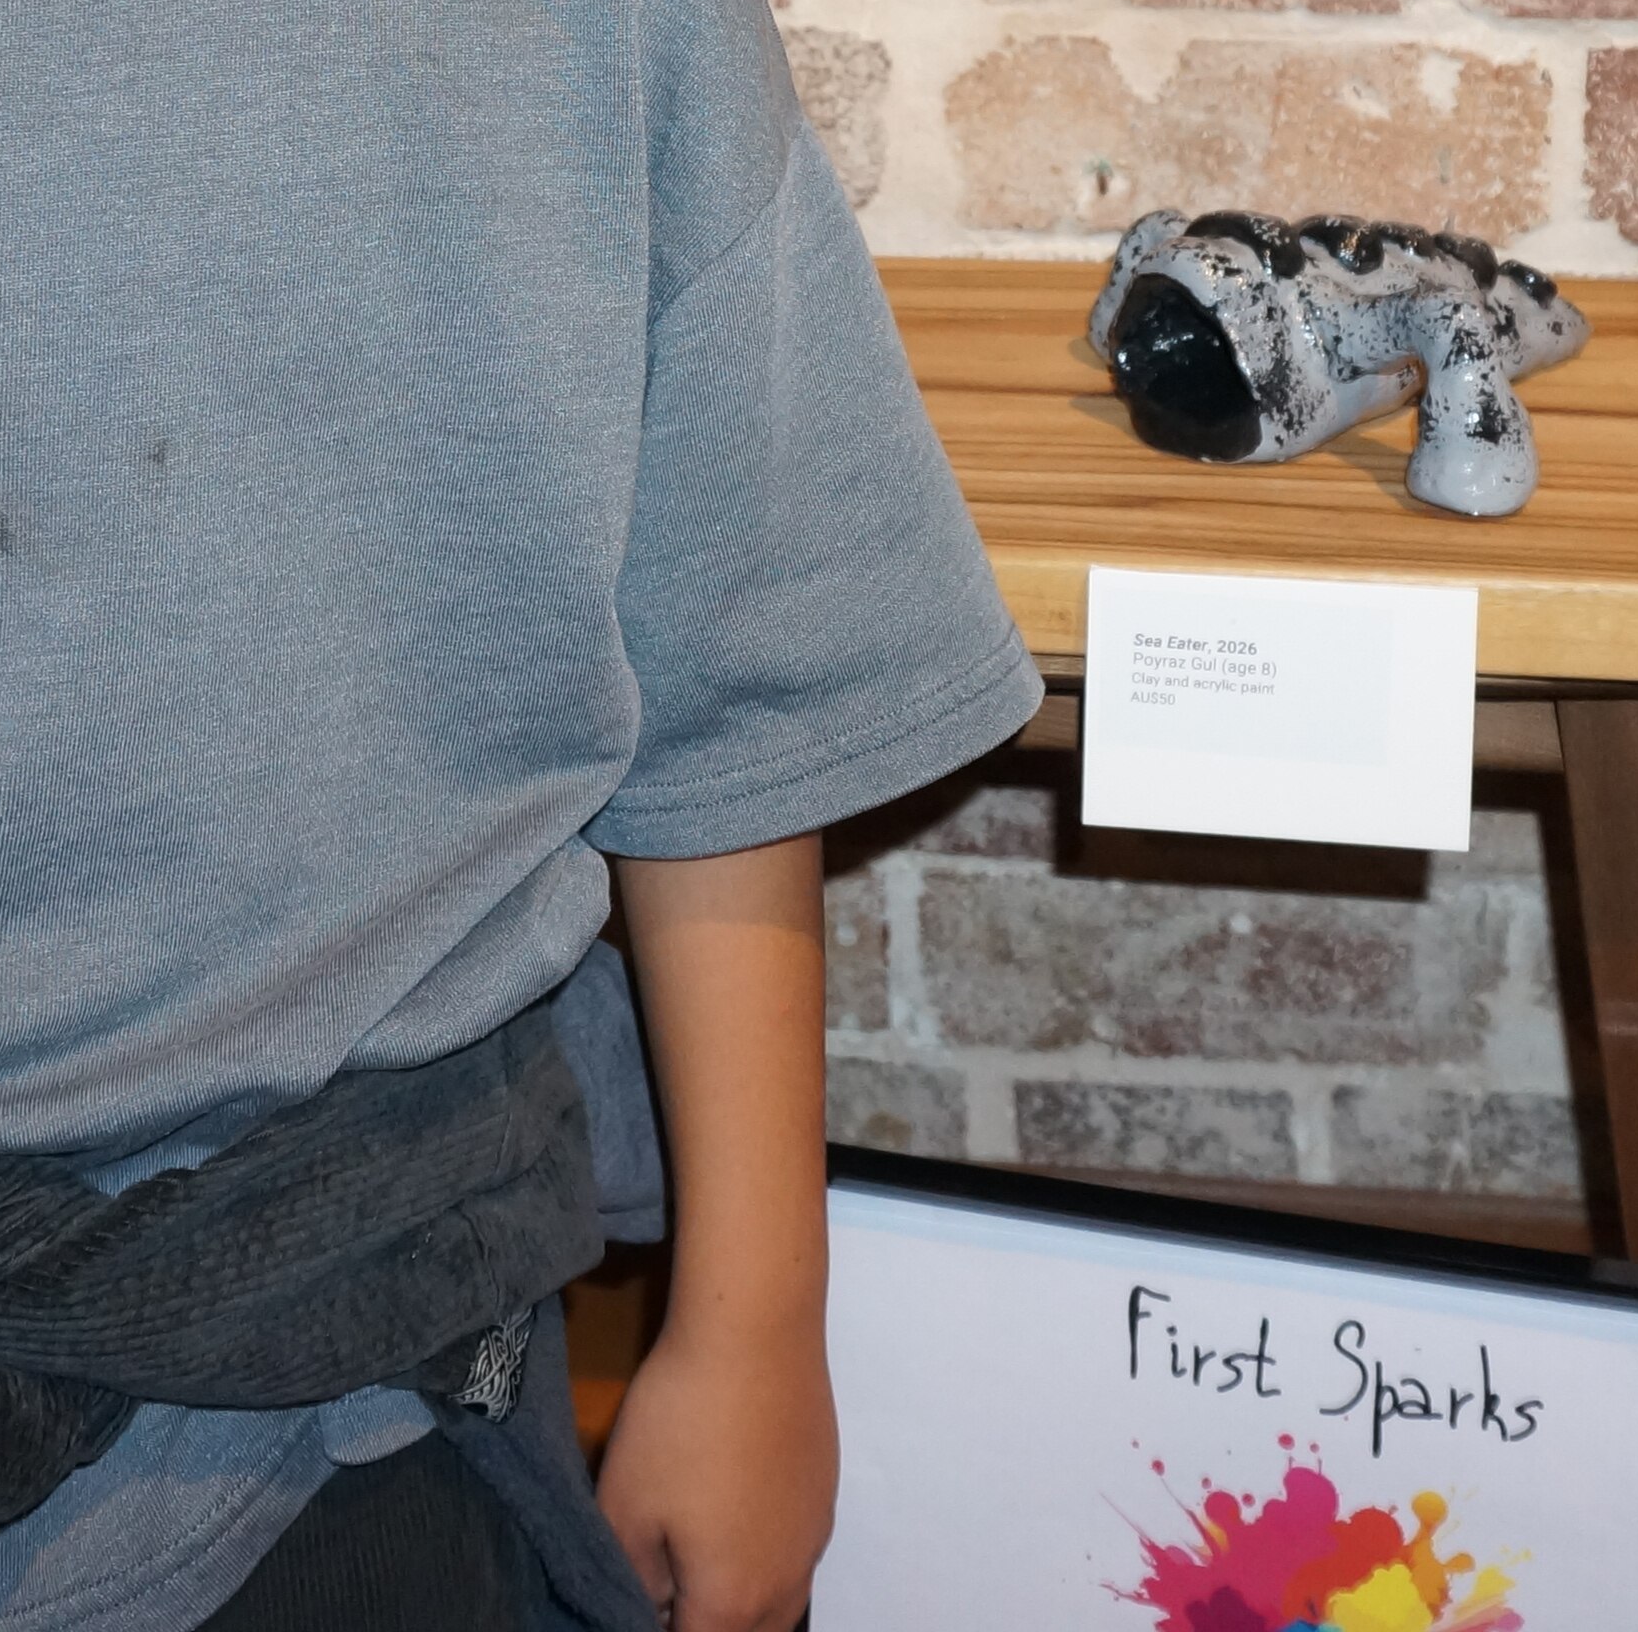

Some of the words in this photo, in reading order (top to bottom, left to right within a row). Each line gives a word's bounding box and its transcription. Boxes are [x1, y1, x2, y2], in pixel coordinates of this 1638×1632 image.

[1133, 633, 1162, 649] Sea
[1167, 635, 1212, 655] Eater,
[1216, 639, 1258, 656] 2026
[1133, 651, 1186, 670] Poyraz
[1191, 657, 1217, 671] Gul
[1222, 658, 1257, 678] (age
[1261, 661, 1277, 679] 8)
[1131, 672, 1161, 688] Clay
[1164, 676, 1190, 688] and
[1193, 679, 1237, 693] acrylic
[1241, 682, 1275, 695] paint
[1130, 691, 1176, 706] AU$50
[1128, 1285, 1282, 1397] First
[1318, 1319, 1545, 1458] Sparks
